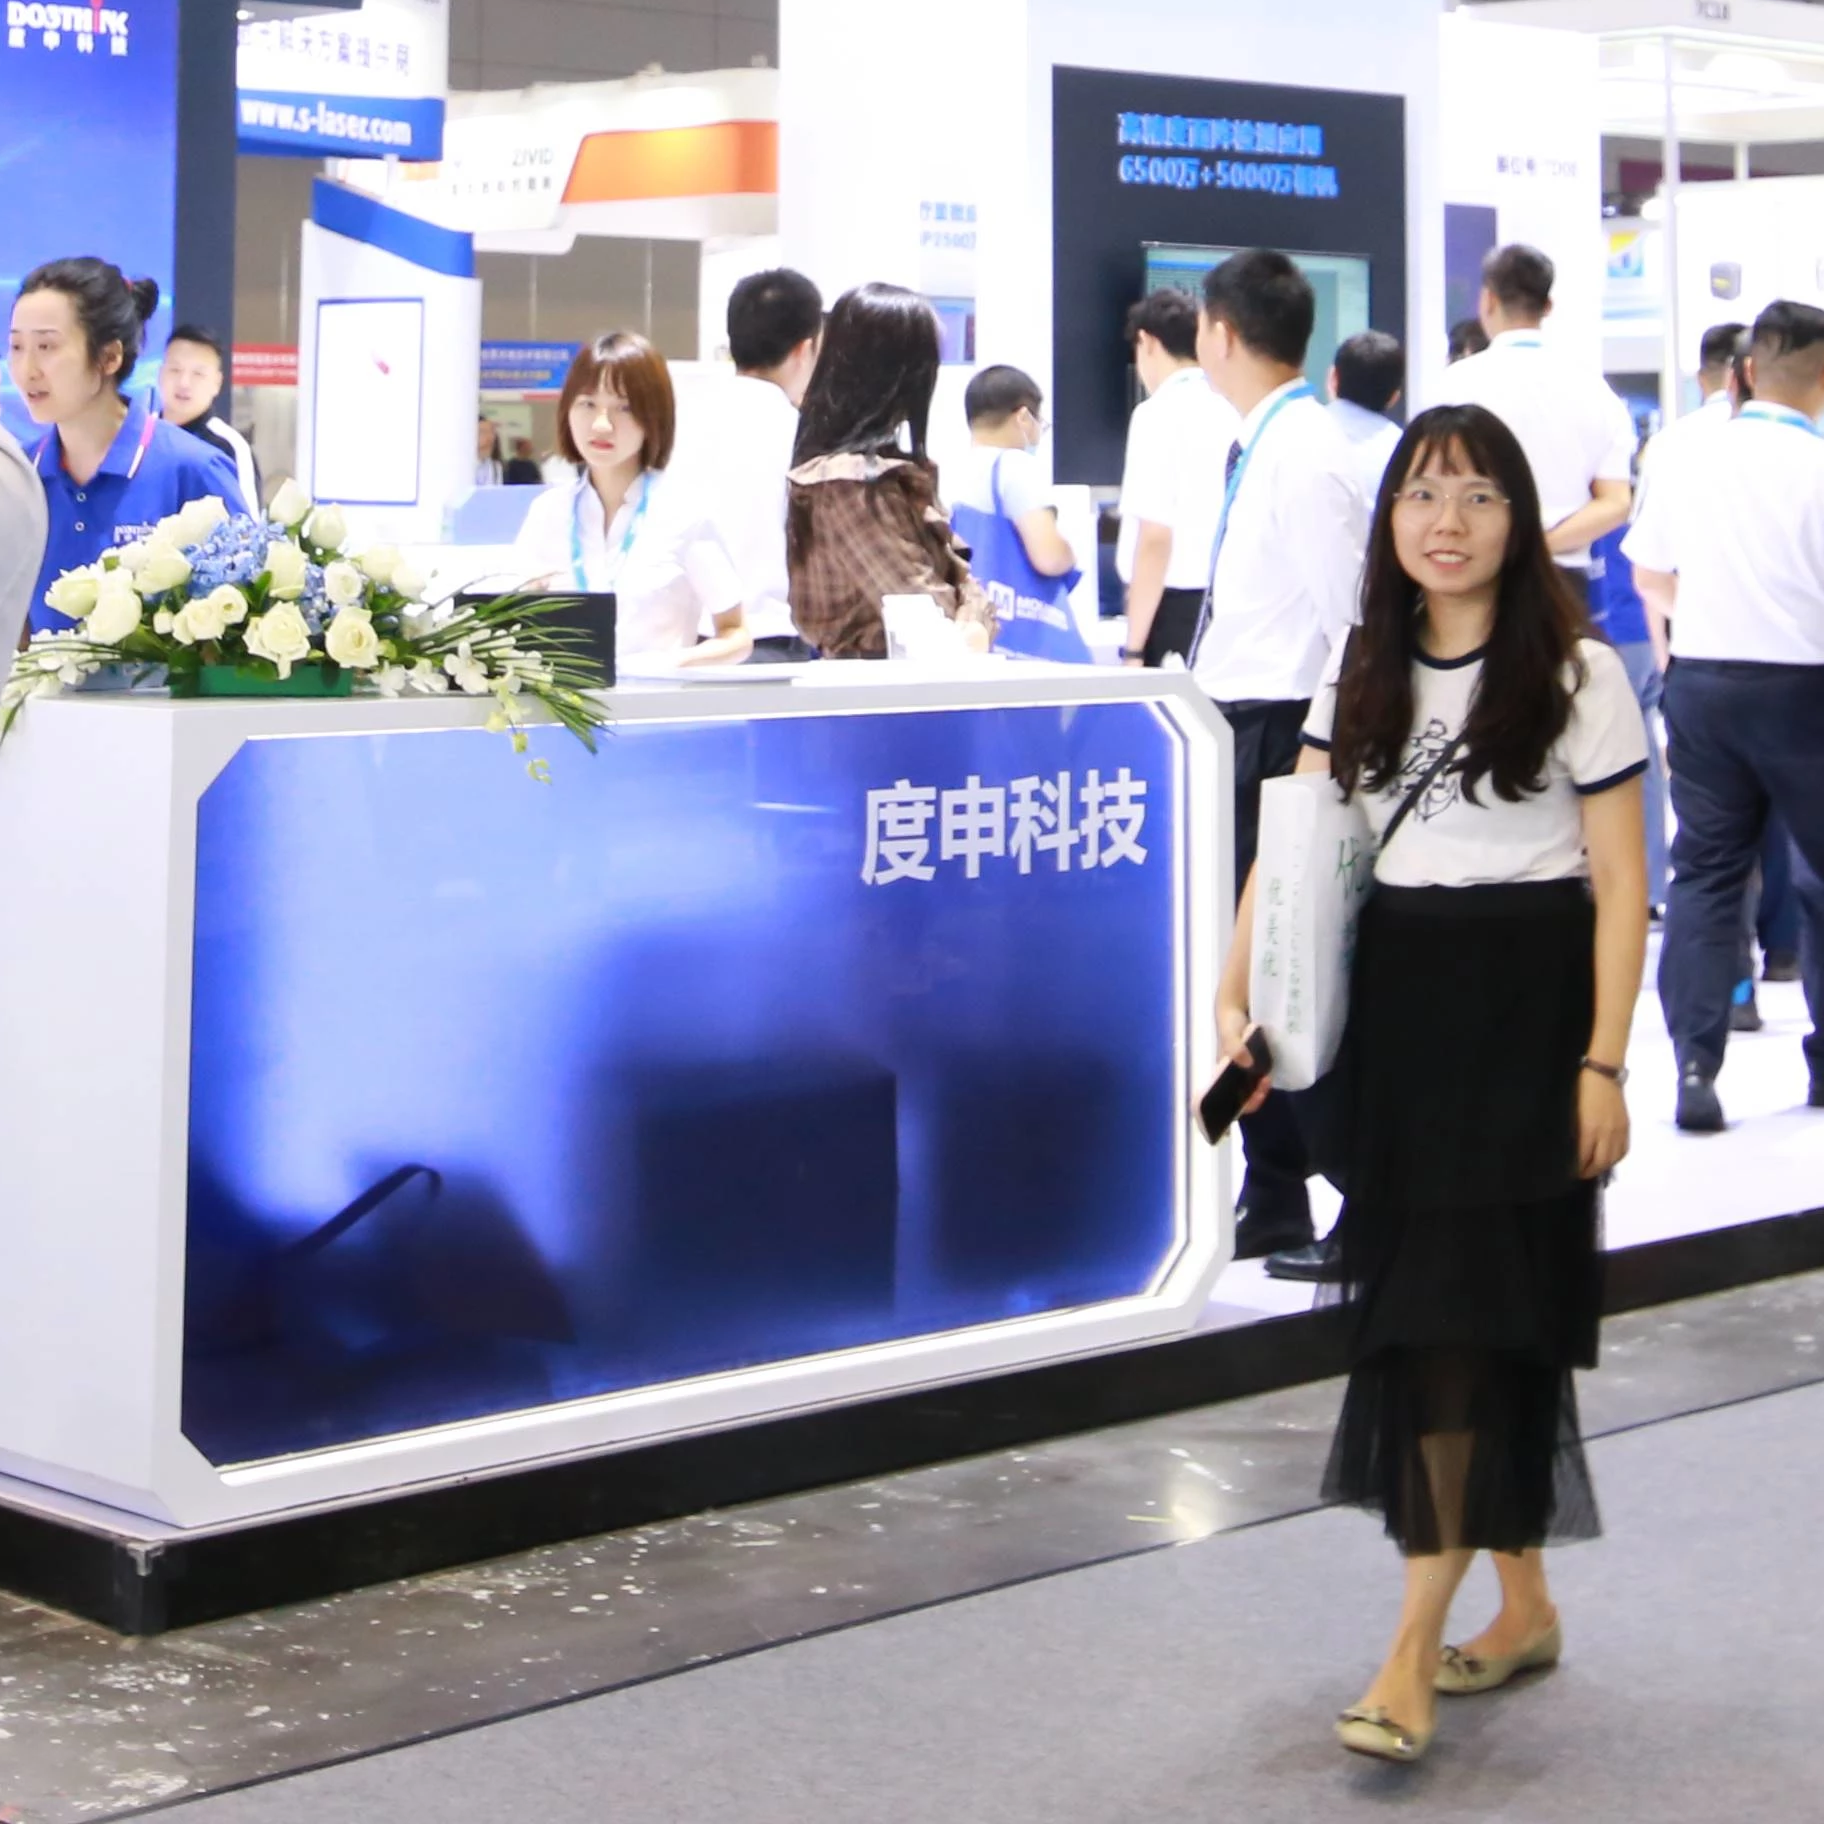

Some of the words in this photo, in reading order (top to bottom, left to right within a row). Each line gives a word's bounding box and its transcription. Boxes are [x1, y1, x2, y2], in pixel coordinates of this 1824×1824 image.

[239, 98, 413, 147] www.s-laser.com
[860, 767, 1149, 886] 度申科技
